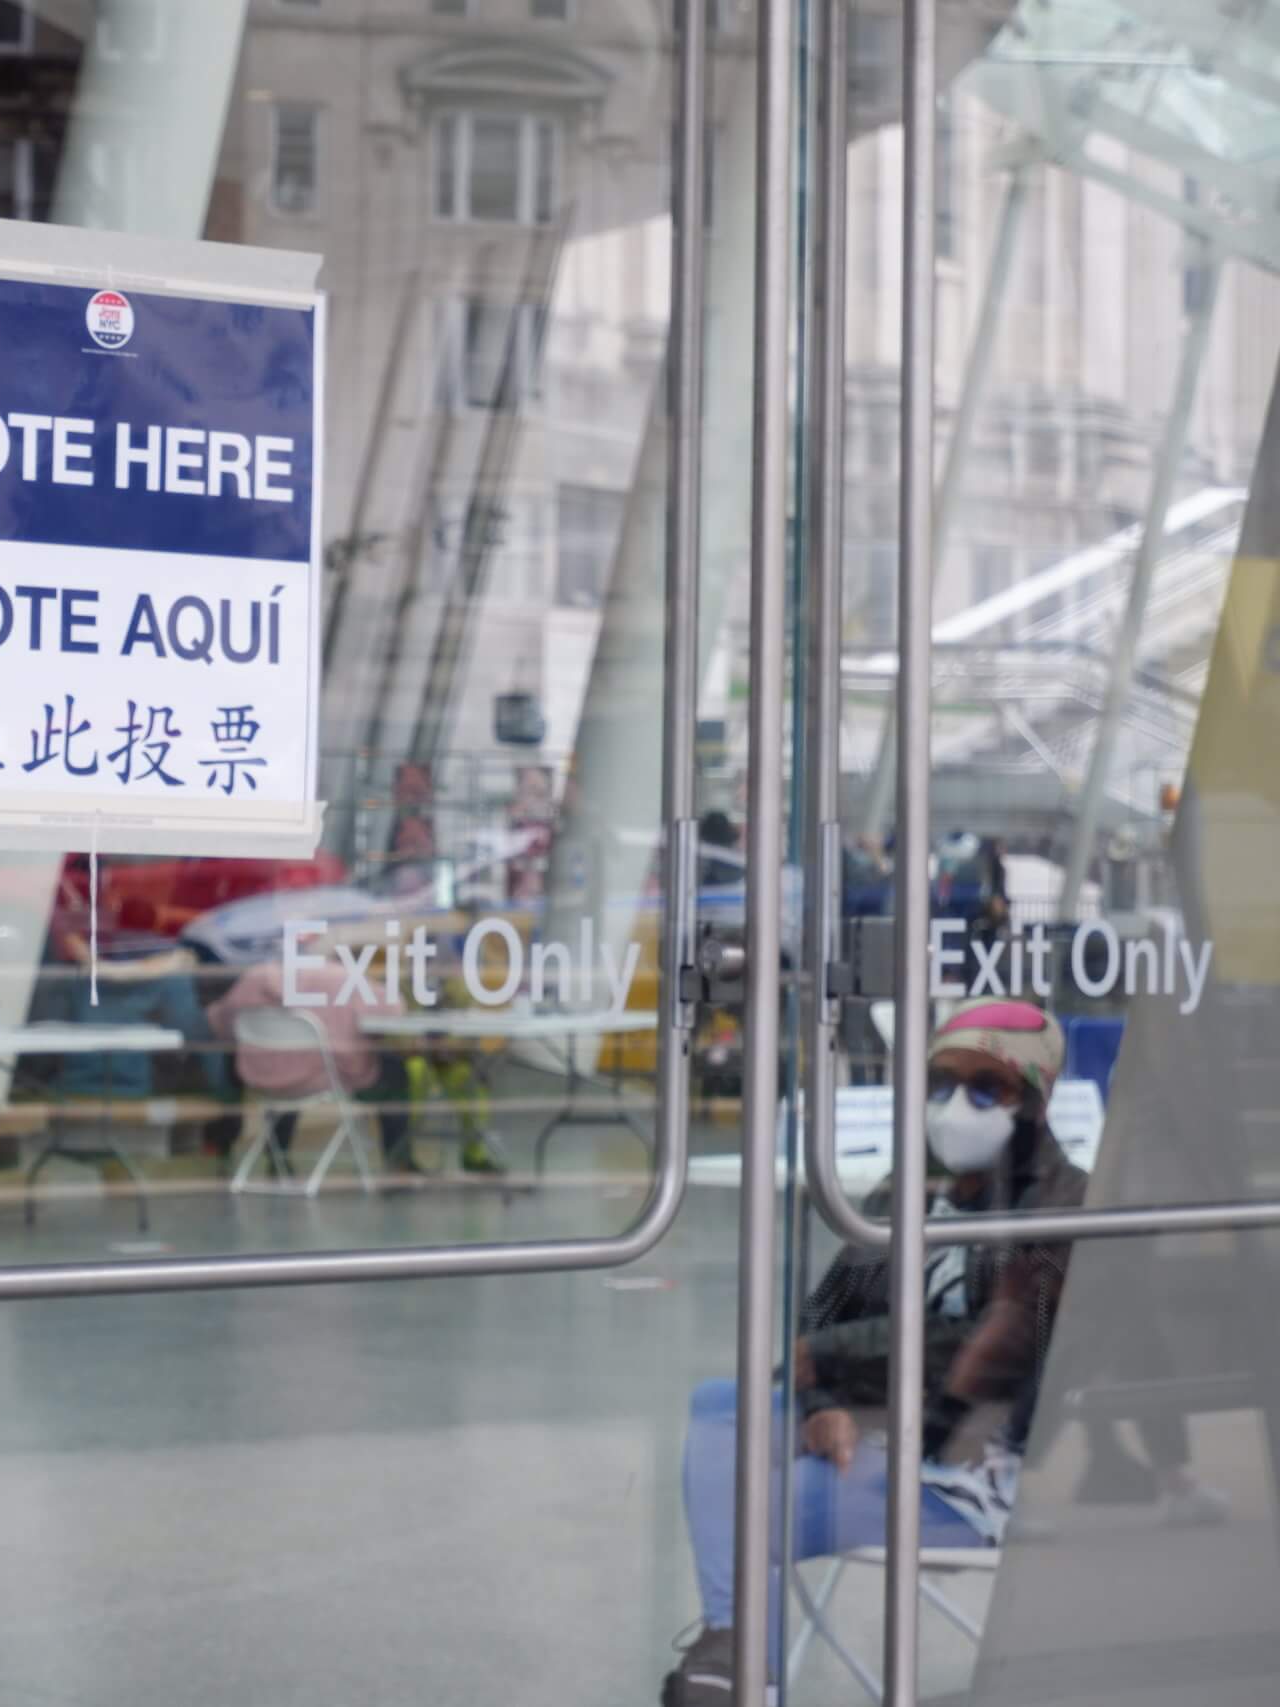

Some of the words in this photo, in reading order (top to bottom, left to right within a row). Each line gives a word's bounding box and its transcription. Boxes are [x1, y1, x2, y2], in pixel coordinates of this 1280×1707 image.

[115, 422, 294, 502] HERE
[120, 585, 286, 665] AQUÍ
[281, 919, 437, 1008] Exit
[462, 916, 641, 1018] Only
[929, 917, 1053, 998] Exit
[1071, 913, 1213, 1016] Only
